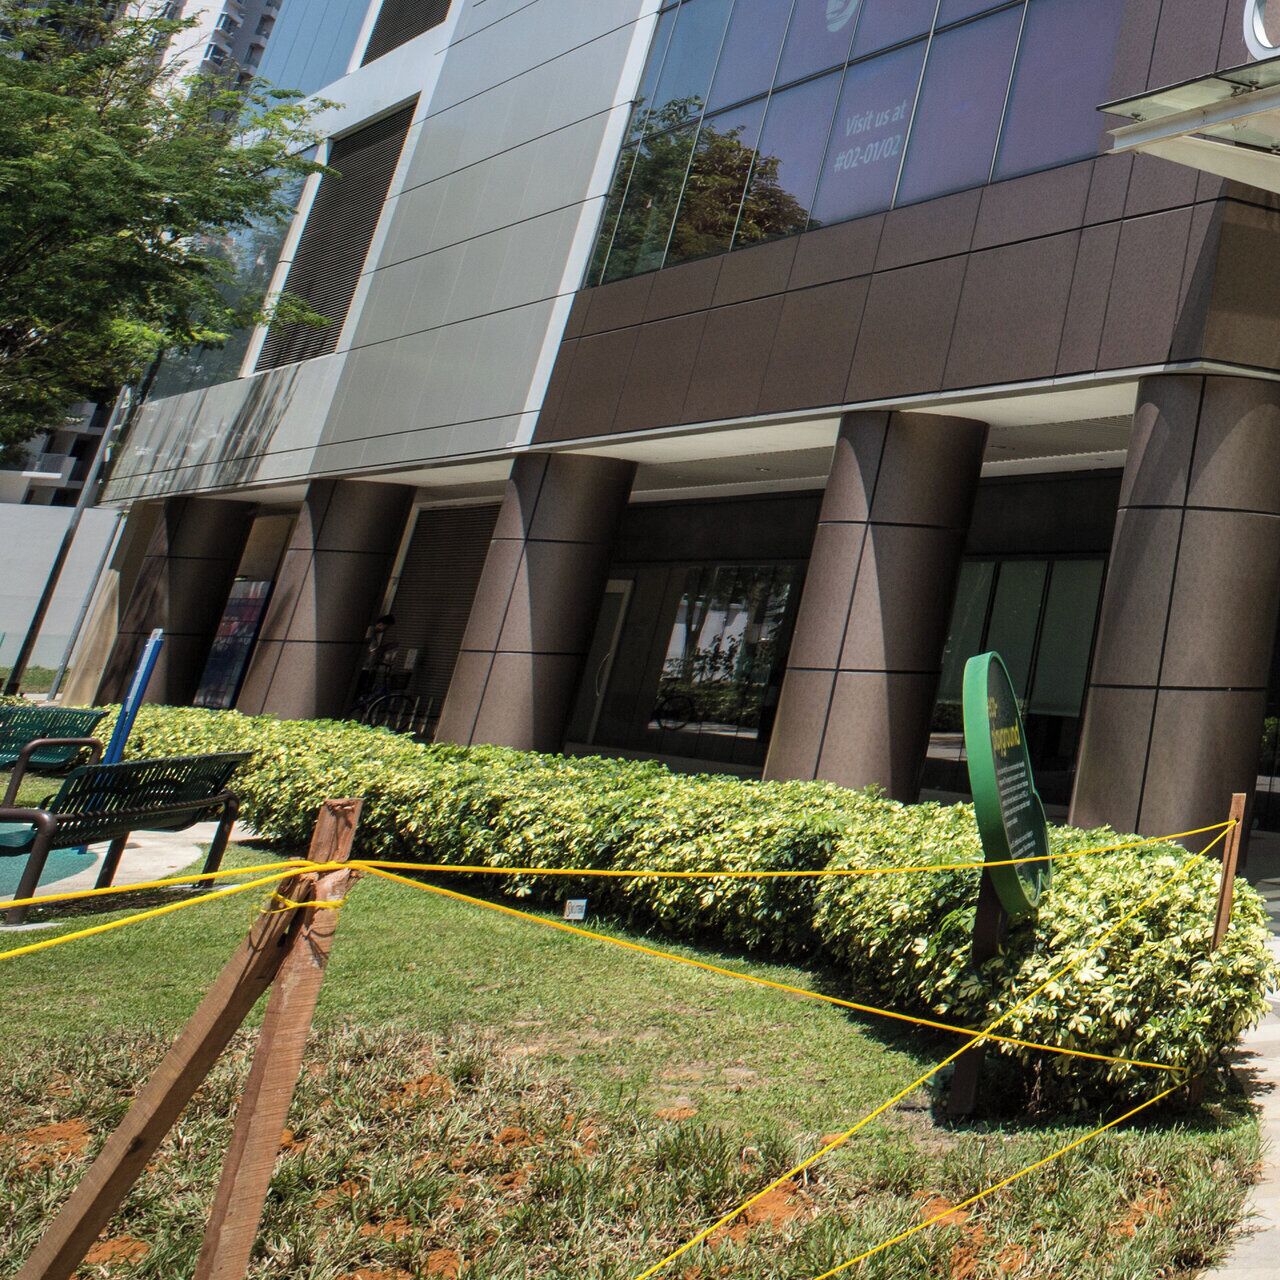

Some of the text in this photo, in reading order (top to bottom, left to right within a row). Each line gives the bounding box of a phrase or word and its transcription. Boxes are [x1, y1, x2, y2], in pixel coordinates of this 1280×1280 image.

[846, 99, 908, 137] Visit us at
[833, 134, 903, 172] #02-01/02
